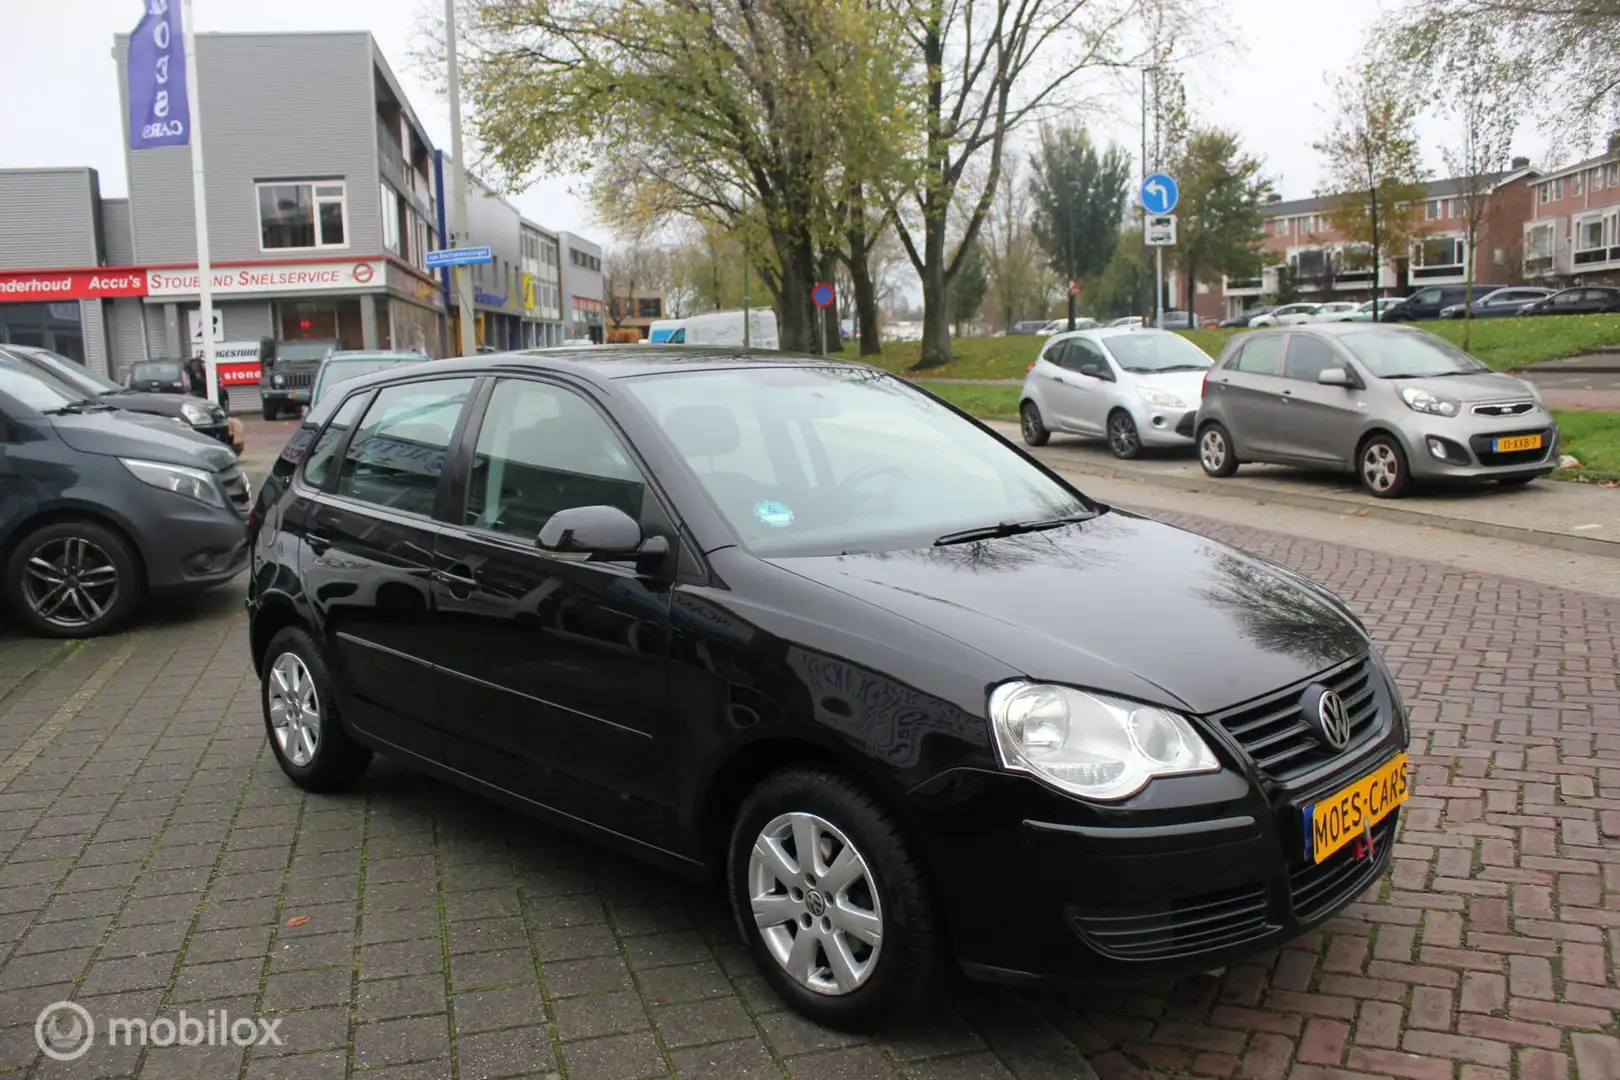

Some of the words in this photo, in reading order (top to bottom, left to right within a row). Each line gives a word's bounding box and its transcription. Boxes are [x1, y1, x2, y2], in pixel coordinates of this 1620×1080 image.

[0, 278, 71, 293] nderhoud
[88, 275, 141, 289] Accu's
[238, 270, 340, 287] SNELSERVICE
[223, 370, 261, 381] stone
